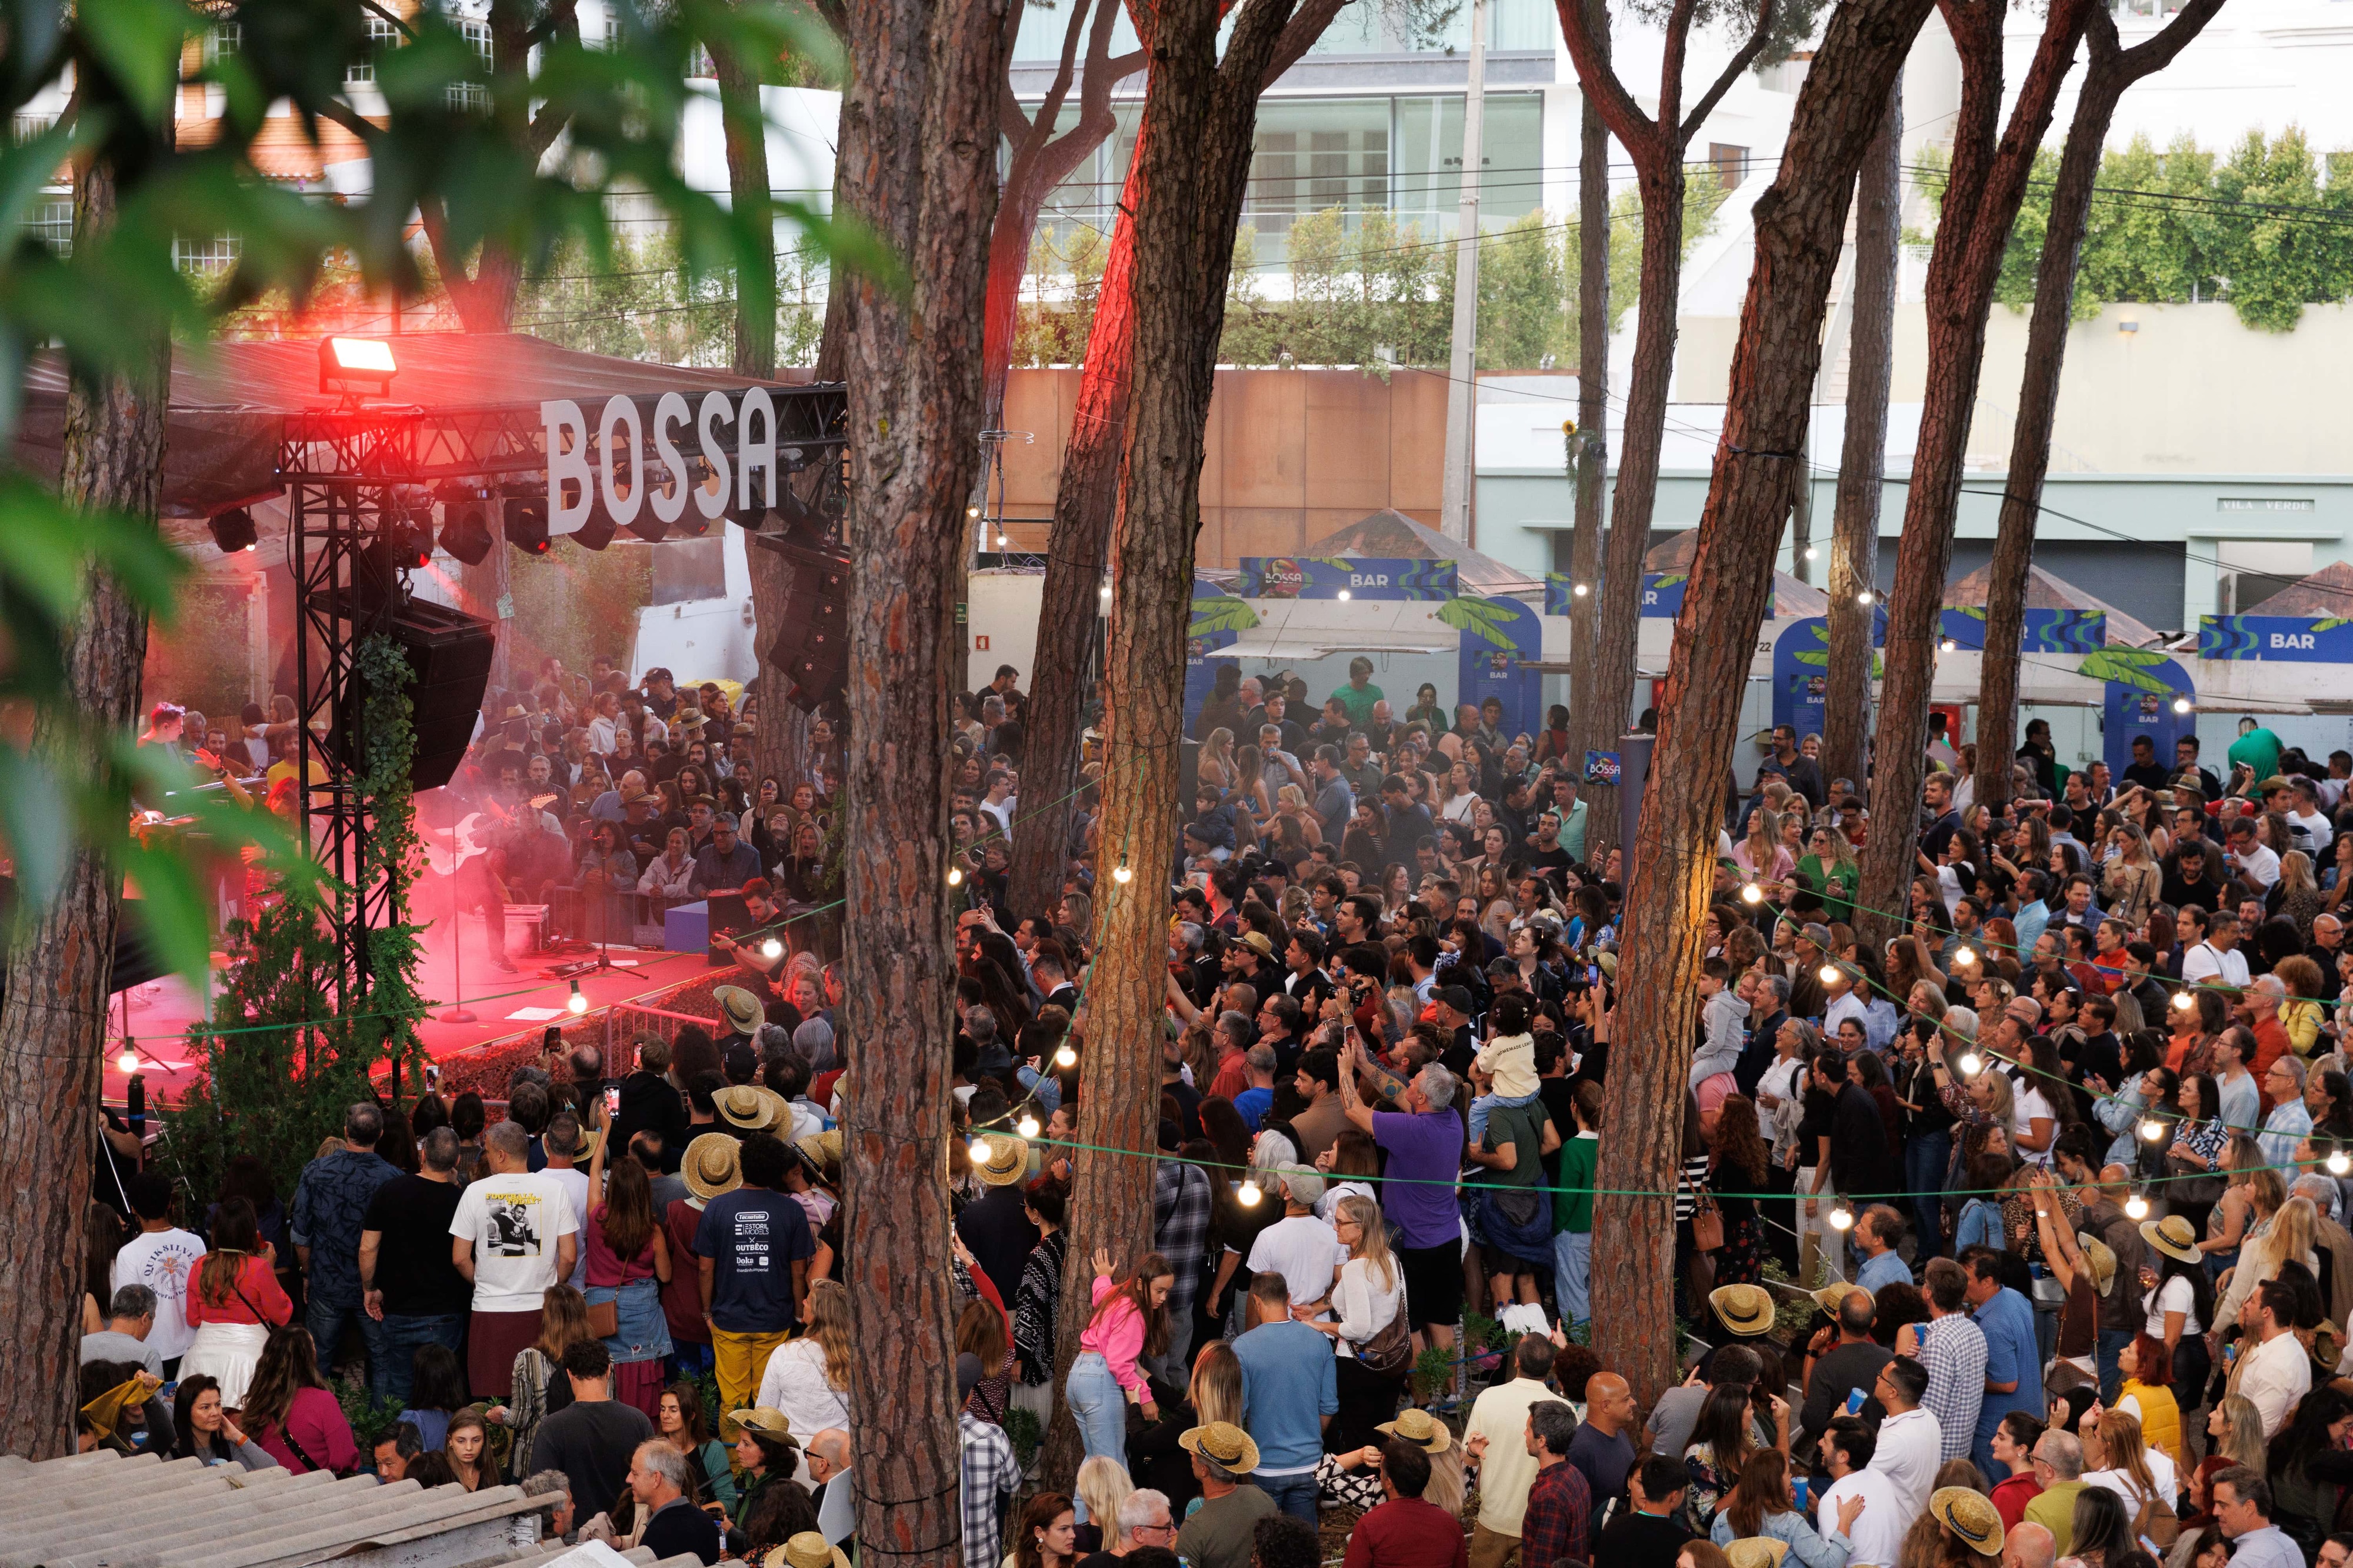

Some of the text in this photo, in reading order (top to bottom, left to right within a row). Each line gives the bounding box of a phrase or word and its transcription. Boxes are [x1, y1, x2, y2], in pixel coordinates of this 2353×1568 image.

[541, 386, 776, 536] BOSSA
[2223, 501, 2310, 511] VILA VERDE
[1265, 572, 1302, 584] BOSSA
[1351, 574, 1389, 588] BAR
[1759, 642, 1771, 652] 22
[2270, 633, 2315, 649] BAR
[2138, 715, 2159, 723] BAR
[1590, 763, 1621, 775] BOSSA
[1497, 1043, 1522, 1057] HOMEMADE
[485, 1192, 536, 1200] FOOTBALL
[735, 1243, 769, 1251] OUTBÊCO
[144, 1244, 196, 1276] QUIKSILVE
